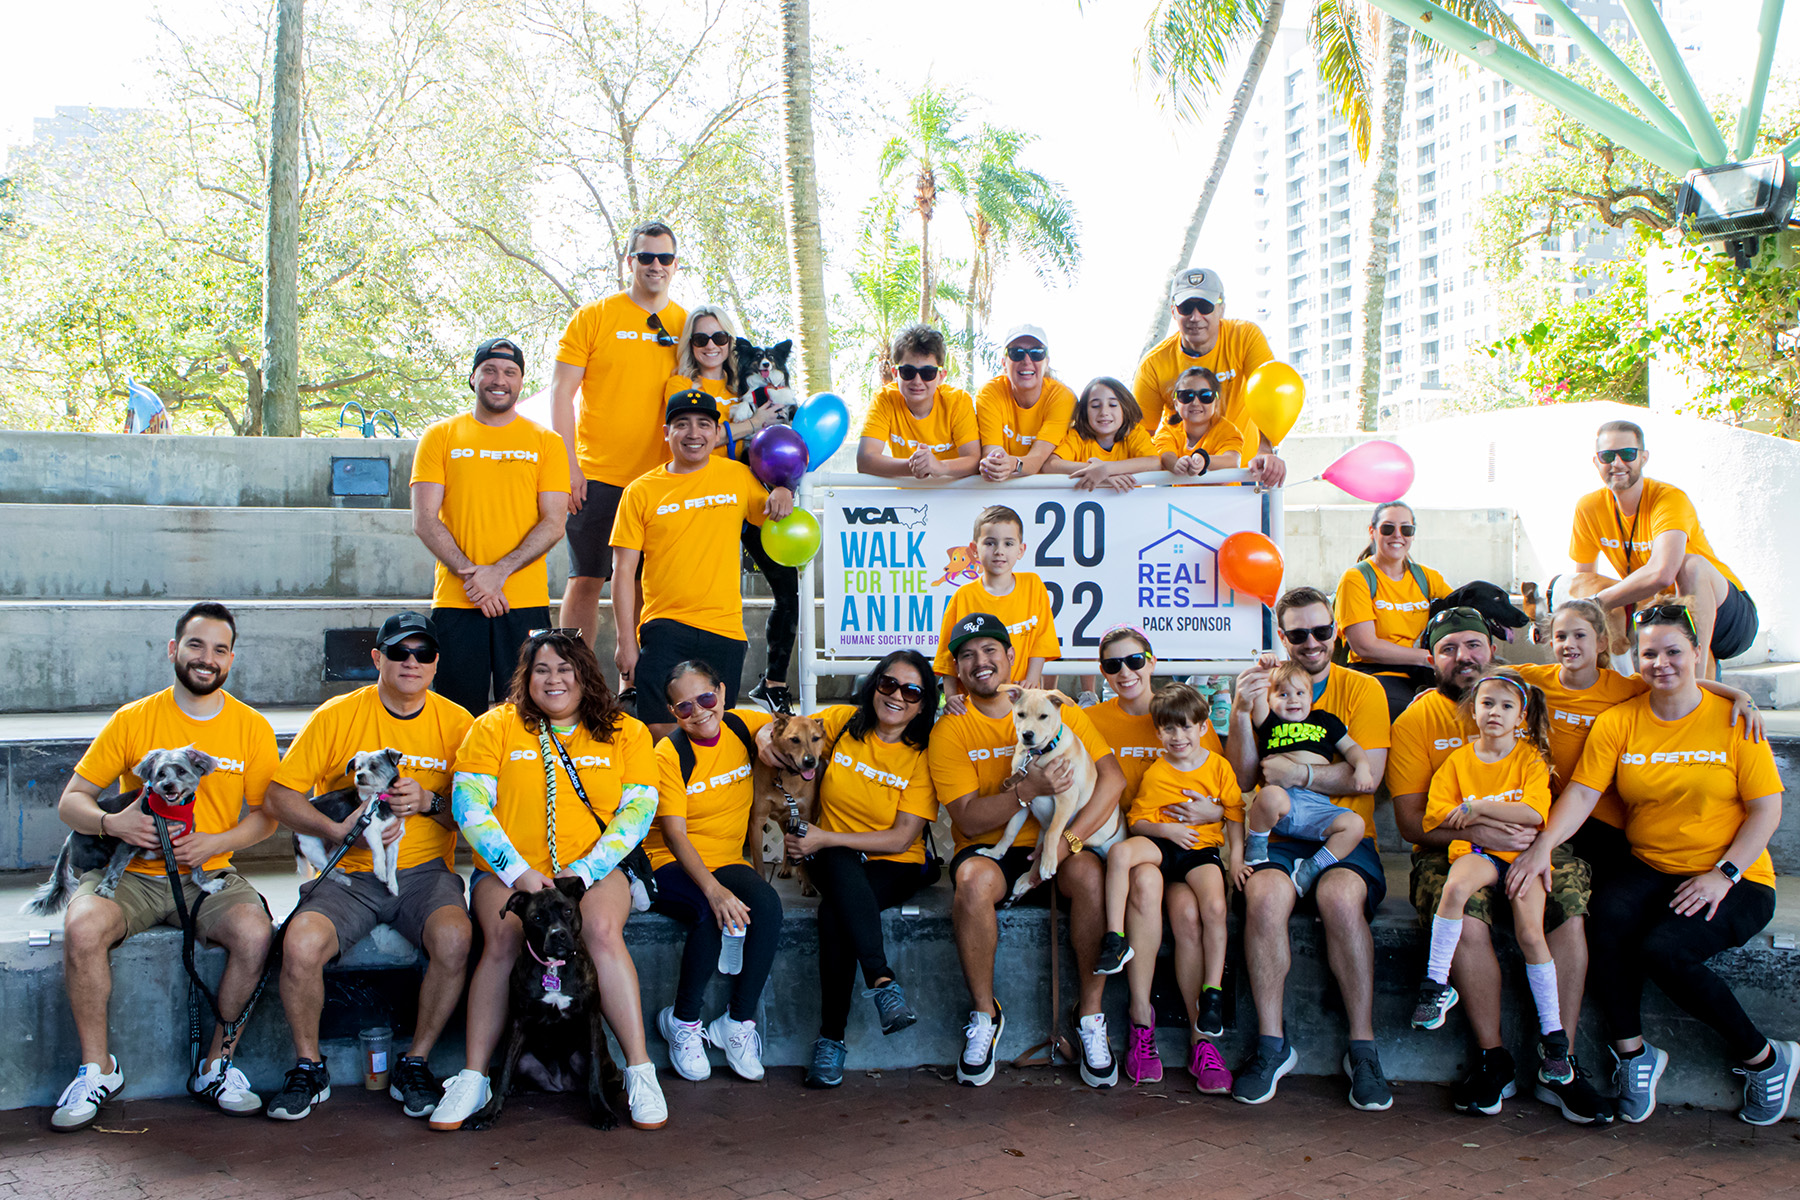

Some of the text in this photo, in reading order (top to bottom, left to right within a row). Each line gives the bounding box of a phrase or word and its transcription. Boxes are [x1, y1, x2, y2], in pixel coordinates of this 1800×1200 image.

[616, 331, 638, 340] SO
[891, 433, 953, 453] SO FTCH
[451, 448, 475, 459] SO
[480, 449, 538, 462] FETCH
[656, 503, 680, 515] SO
[684, 494, 737, 509] FETCH
[842, 507, 900, 525] VCA
[1035, 501, 1105, 567] 20
[1600, 537, 1619, 548] SO
[840, 531, 926, 568] WALK
[844, 570, 927, 593] FOR THE
[1138, 563, 1206, 584] REAL
[1138, 587, 1190, 607] RES
[1375, 600, 1394, 610] SO
[1143, 617, 1231, 631] PACK SPONSOR
[840, 635, 875, 645] HUMANE
[878, 635, 912, 645] SOCIETY
[915, 635, 926, 645] OF
[1434, 737, 1463, 750] SO
[510, 750, 538, 761] SO
[968, 749, 991, 761] SO
[1621, 750, 1727, 765] SO FETCH
[566, 764, 580, 789] adidas
[710, 763, 751, 788] FETCH
[834, 752, 853, 767] SO
[854, 762, 909, 790] FETCH
